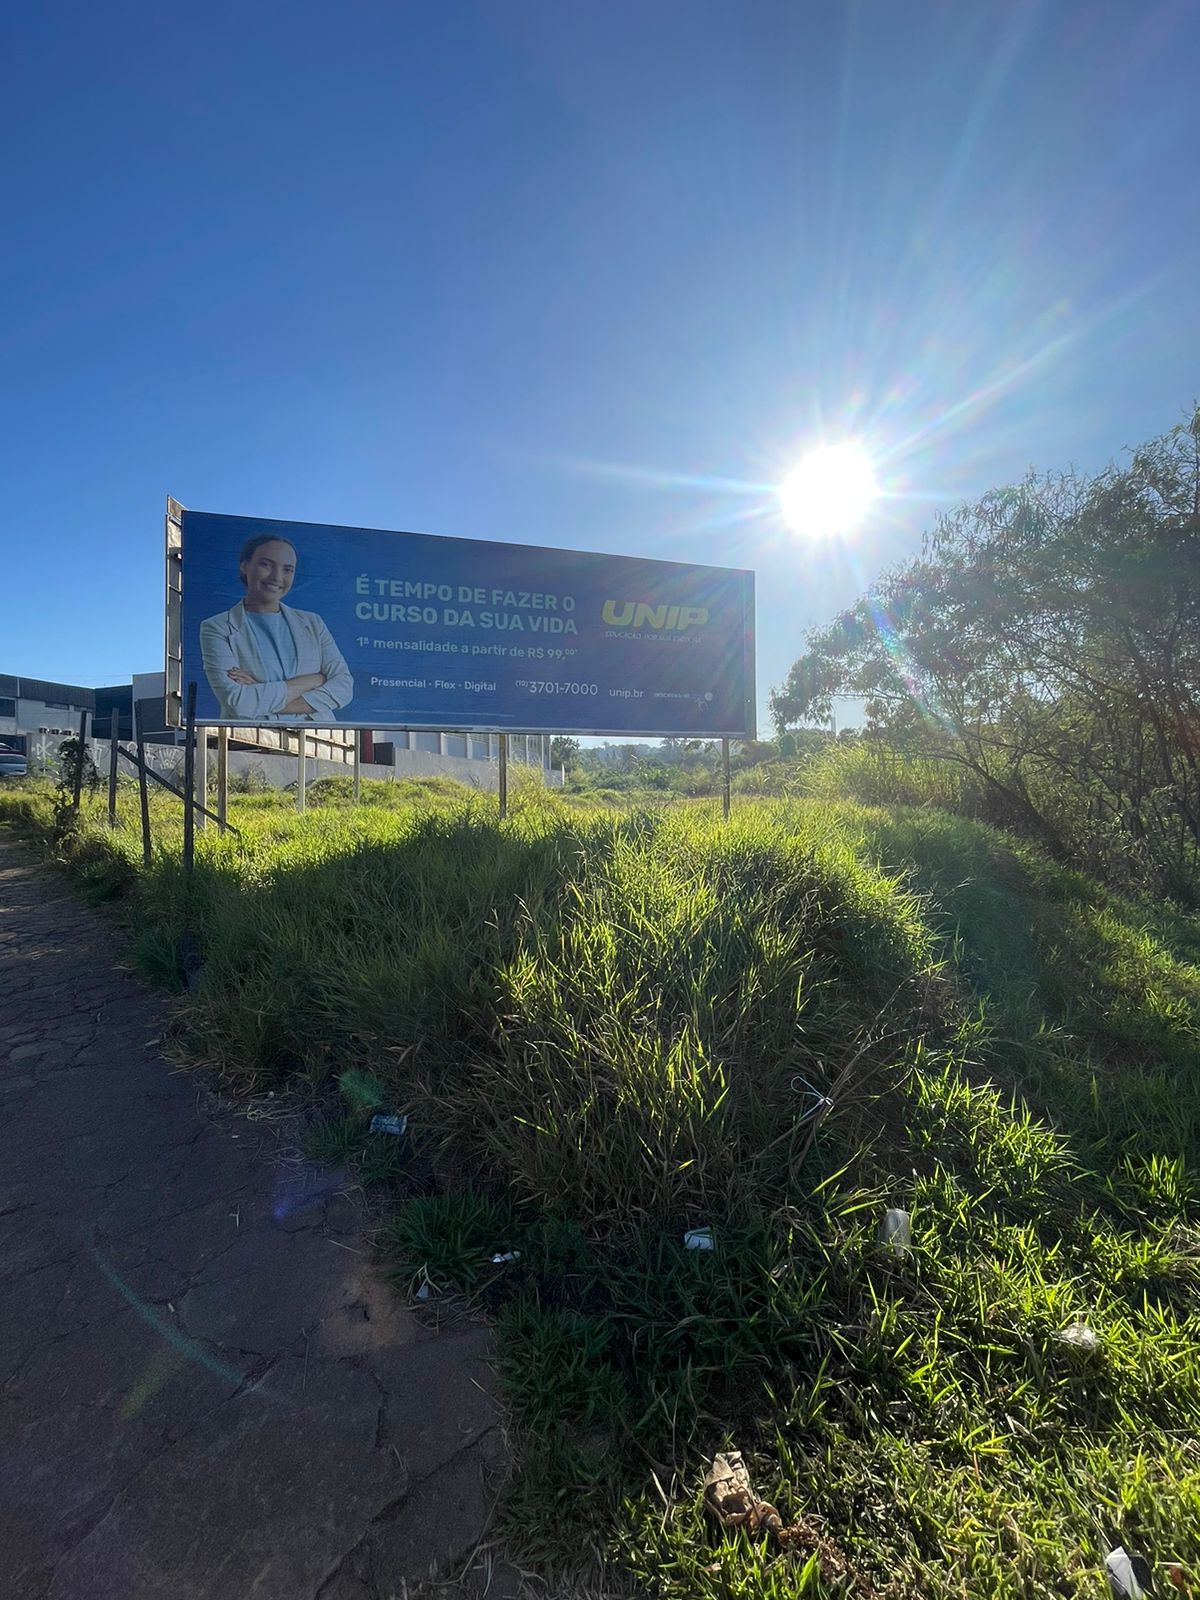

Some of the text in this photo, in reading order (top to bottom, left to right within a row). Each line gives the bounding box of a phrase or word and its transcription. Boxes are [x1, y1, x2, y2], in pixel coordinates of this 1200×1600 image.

[355, 573, 576, 612] É TEMPO DE FAZER O
[355, 602, 578, 635] CURSO DA SUA VIDA
[601, 599, 709, 631] UNIP
[373, 639, 459, 654] mensalidade
[461, 645, 469, 654] a
[472, 645, 507, 657] partir
[509, 645, 525, 658] de
[528, 647, 544, 659] R$
[370, 676, 496, 693] Presencial Flex Digital
[609, 687, 644, 699] unip.br
